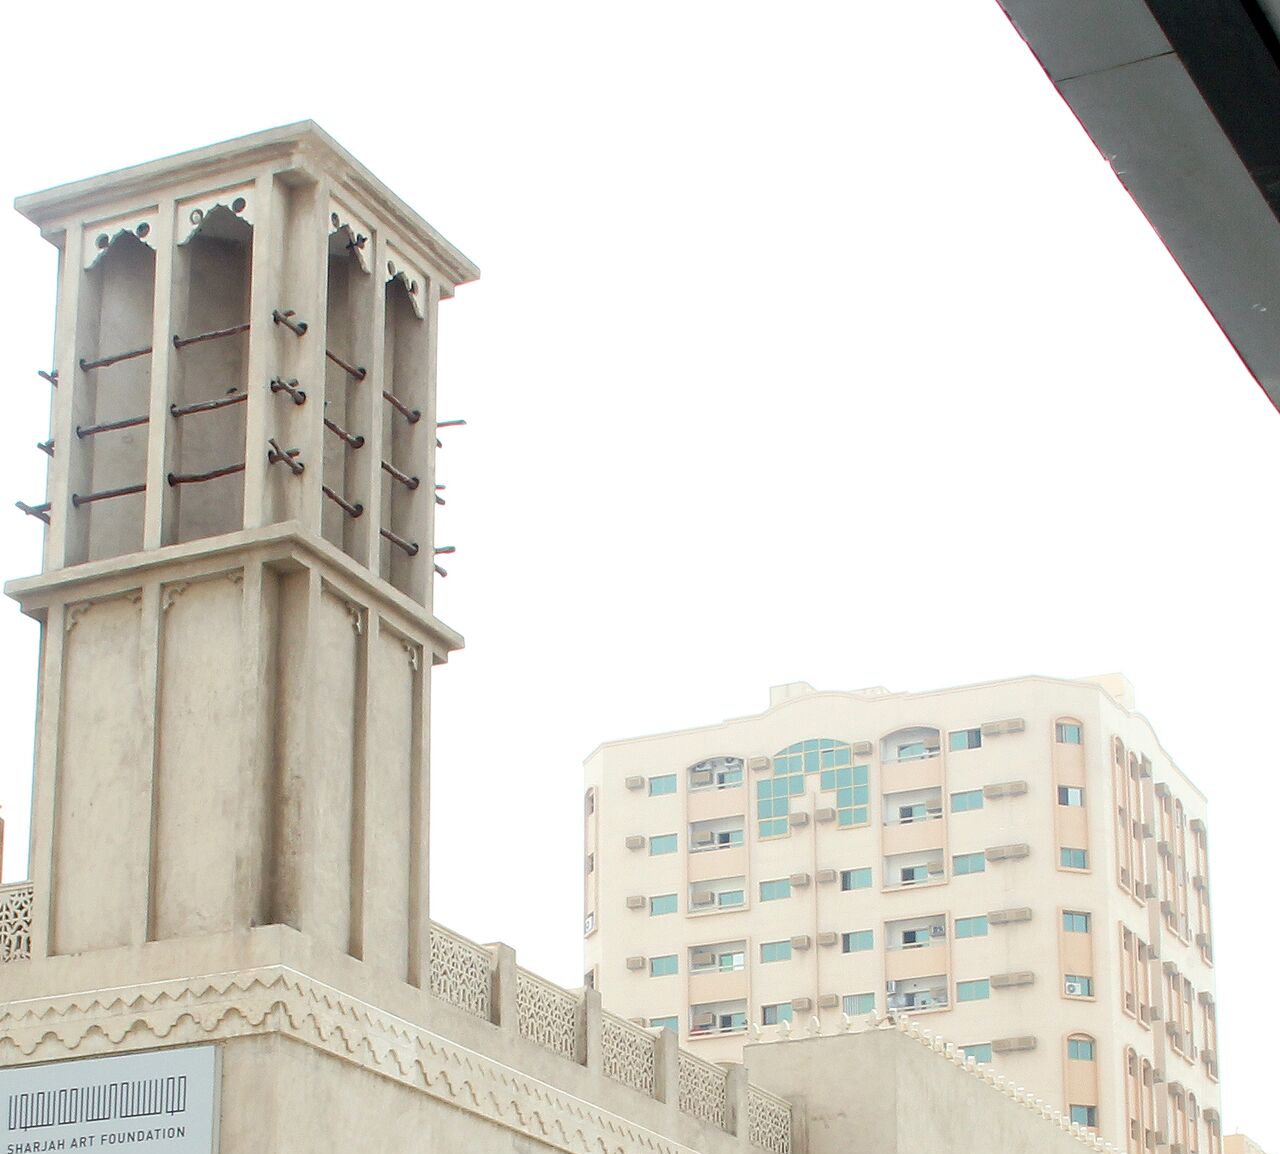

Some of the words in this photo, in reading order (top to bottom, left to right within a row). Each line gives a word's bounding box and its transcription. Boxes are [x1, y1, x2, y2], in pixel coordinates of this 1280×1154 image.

[7, 1138, 66, 1154] SHARJAH
[70, 1136, 95, 1149] ART
[100, 1127, 186, 1146] FOUNDATION
